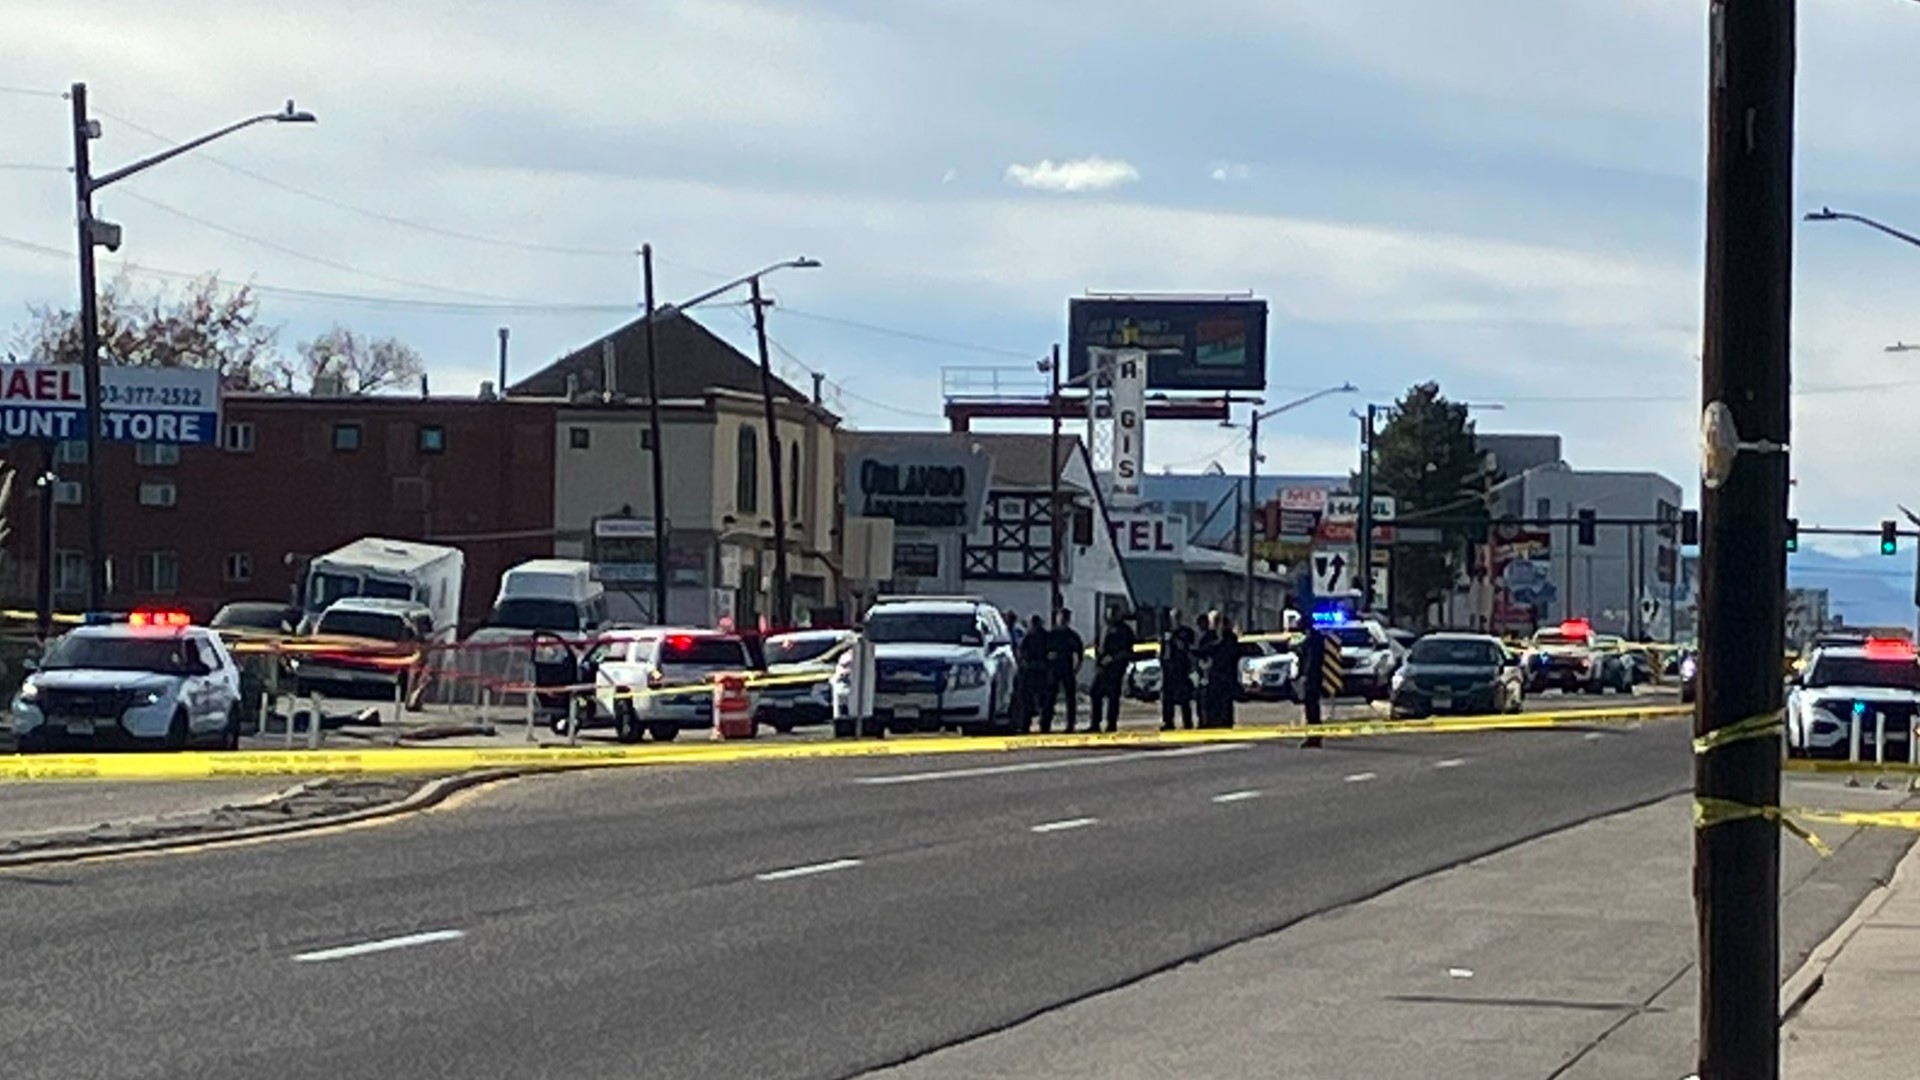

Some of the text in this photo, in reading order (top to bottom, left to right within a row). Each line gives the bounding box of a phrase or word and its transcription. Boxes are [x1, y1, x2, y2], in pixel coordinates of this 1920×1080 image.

[0, 367, 81, 400] AEL
[0, 408, 77, 437] UNT
[860, 458, 966, 497] ORLANDO
